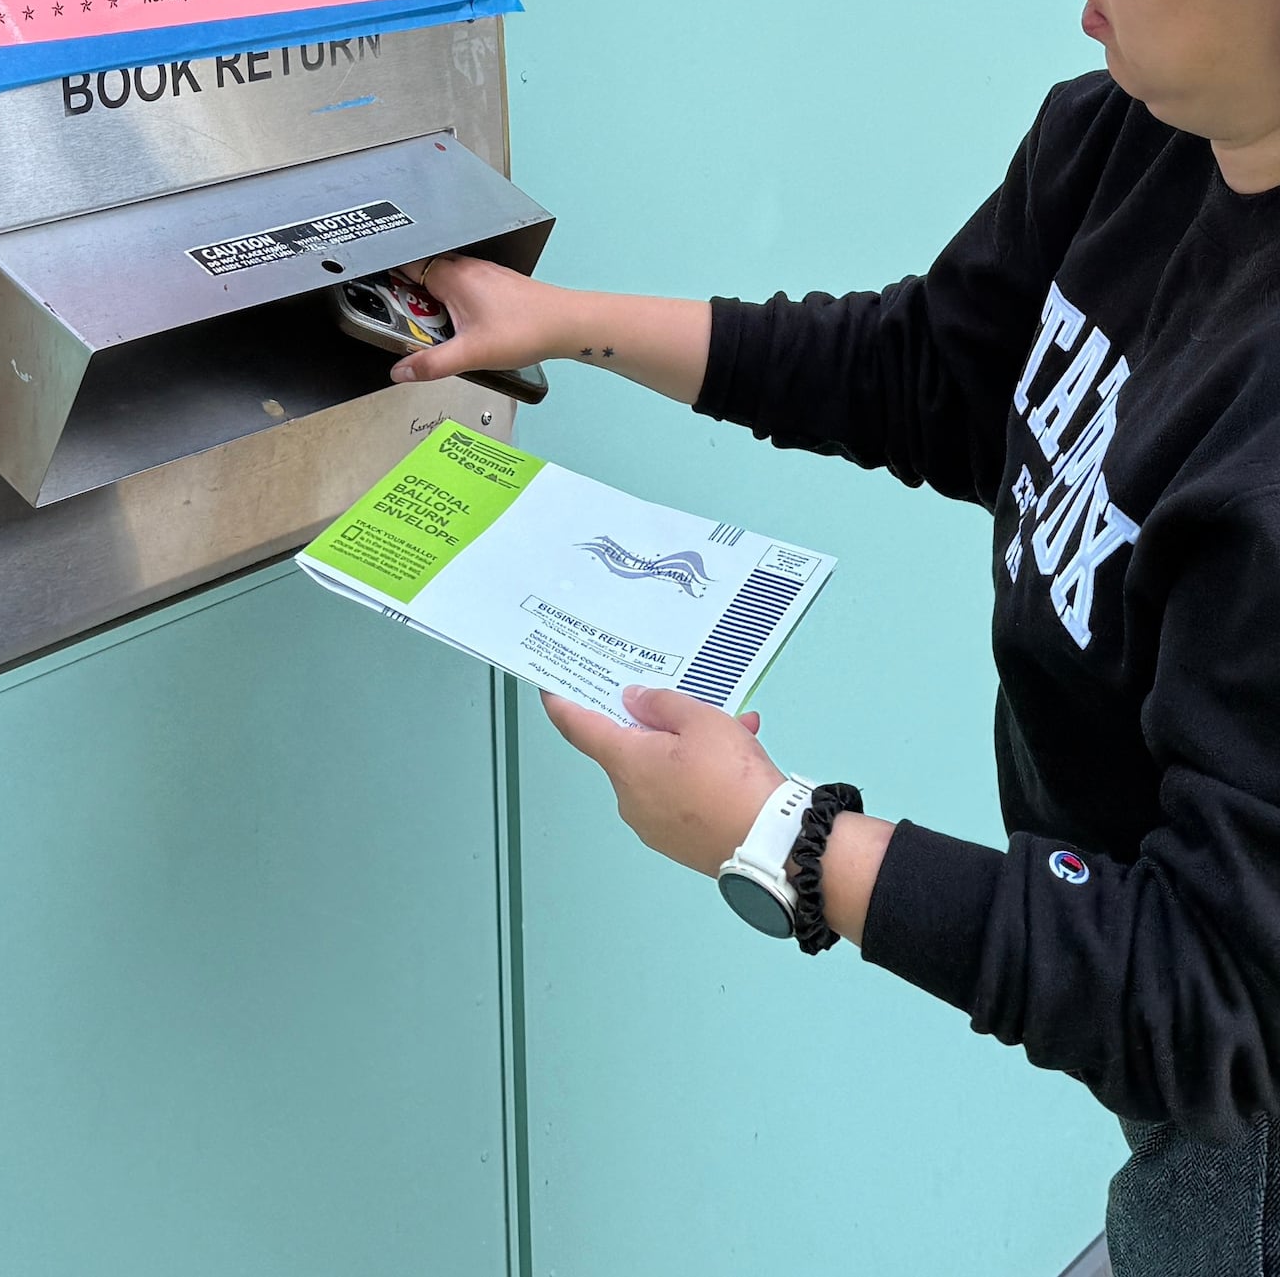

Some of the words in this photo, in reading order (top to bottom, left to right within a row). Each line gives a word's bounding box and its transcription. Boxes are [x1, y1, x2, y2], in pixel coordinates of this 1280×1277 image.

[61, 60, 202, 117] BOOK
[311, 210, 371, 233] NOTICE
[201, 234, 276, 261] CAUTION
[220, 255, 238, 264] NOT
[261, 249, 296, 261] RETURN
[437, 444, 486, 476] Votes
[443, 437, 515, 478] Multnomah
[382, 491, 450, 528] RETURN
[393, 482, 457, 517] BALLOT
[402, 473, 471, 516] OFFICIAL
[356, 519, 383, 533] TRACK
[383, 532, 406, 545] YOUR
[405, 543, 437, 560] BALLOT
[373, 500, 459, 547] ENVELOPE
[538, 603, 597, 637] BUSINESS
[598, 632, 638, 655] REPLY
[638, 648, 668, 664] MAIL
